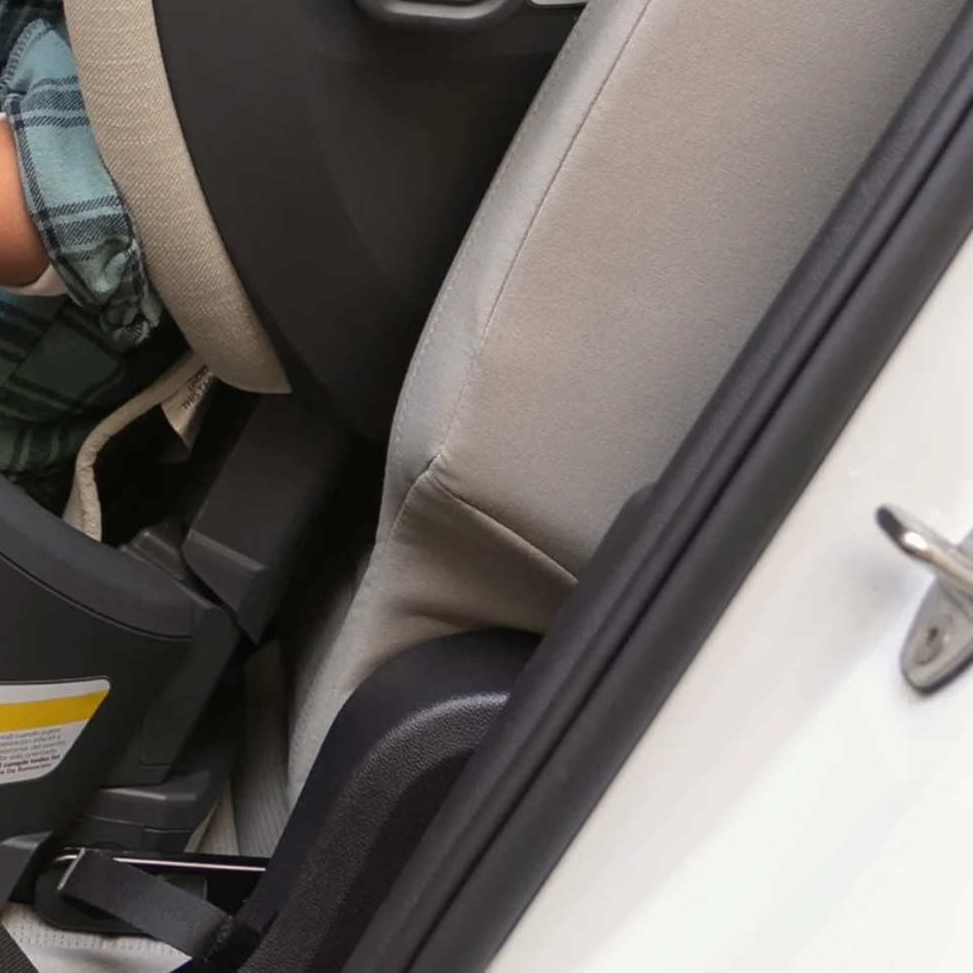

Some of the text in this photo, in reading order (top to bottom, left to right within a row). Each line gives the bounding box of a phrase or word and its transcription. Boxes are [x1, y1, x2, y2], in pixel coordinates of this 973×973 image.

[15, 731, 40, 740] cuando
[4, 758, 29, 768] cumple
[30, 756, 49, 764] todas
